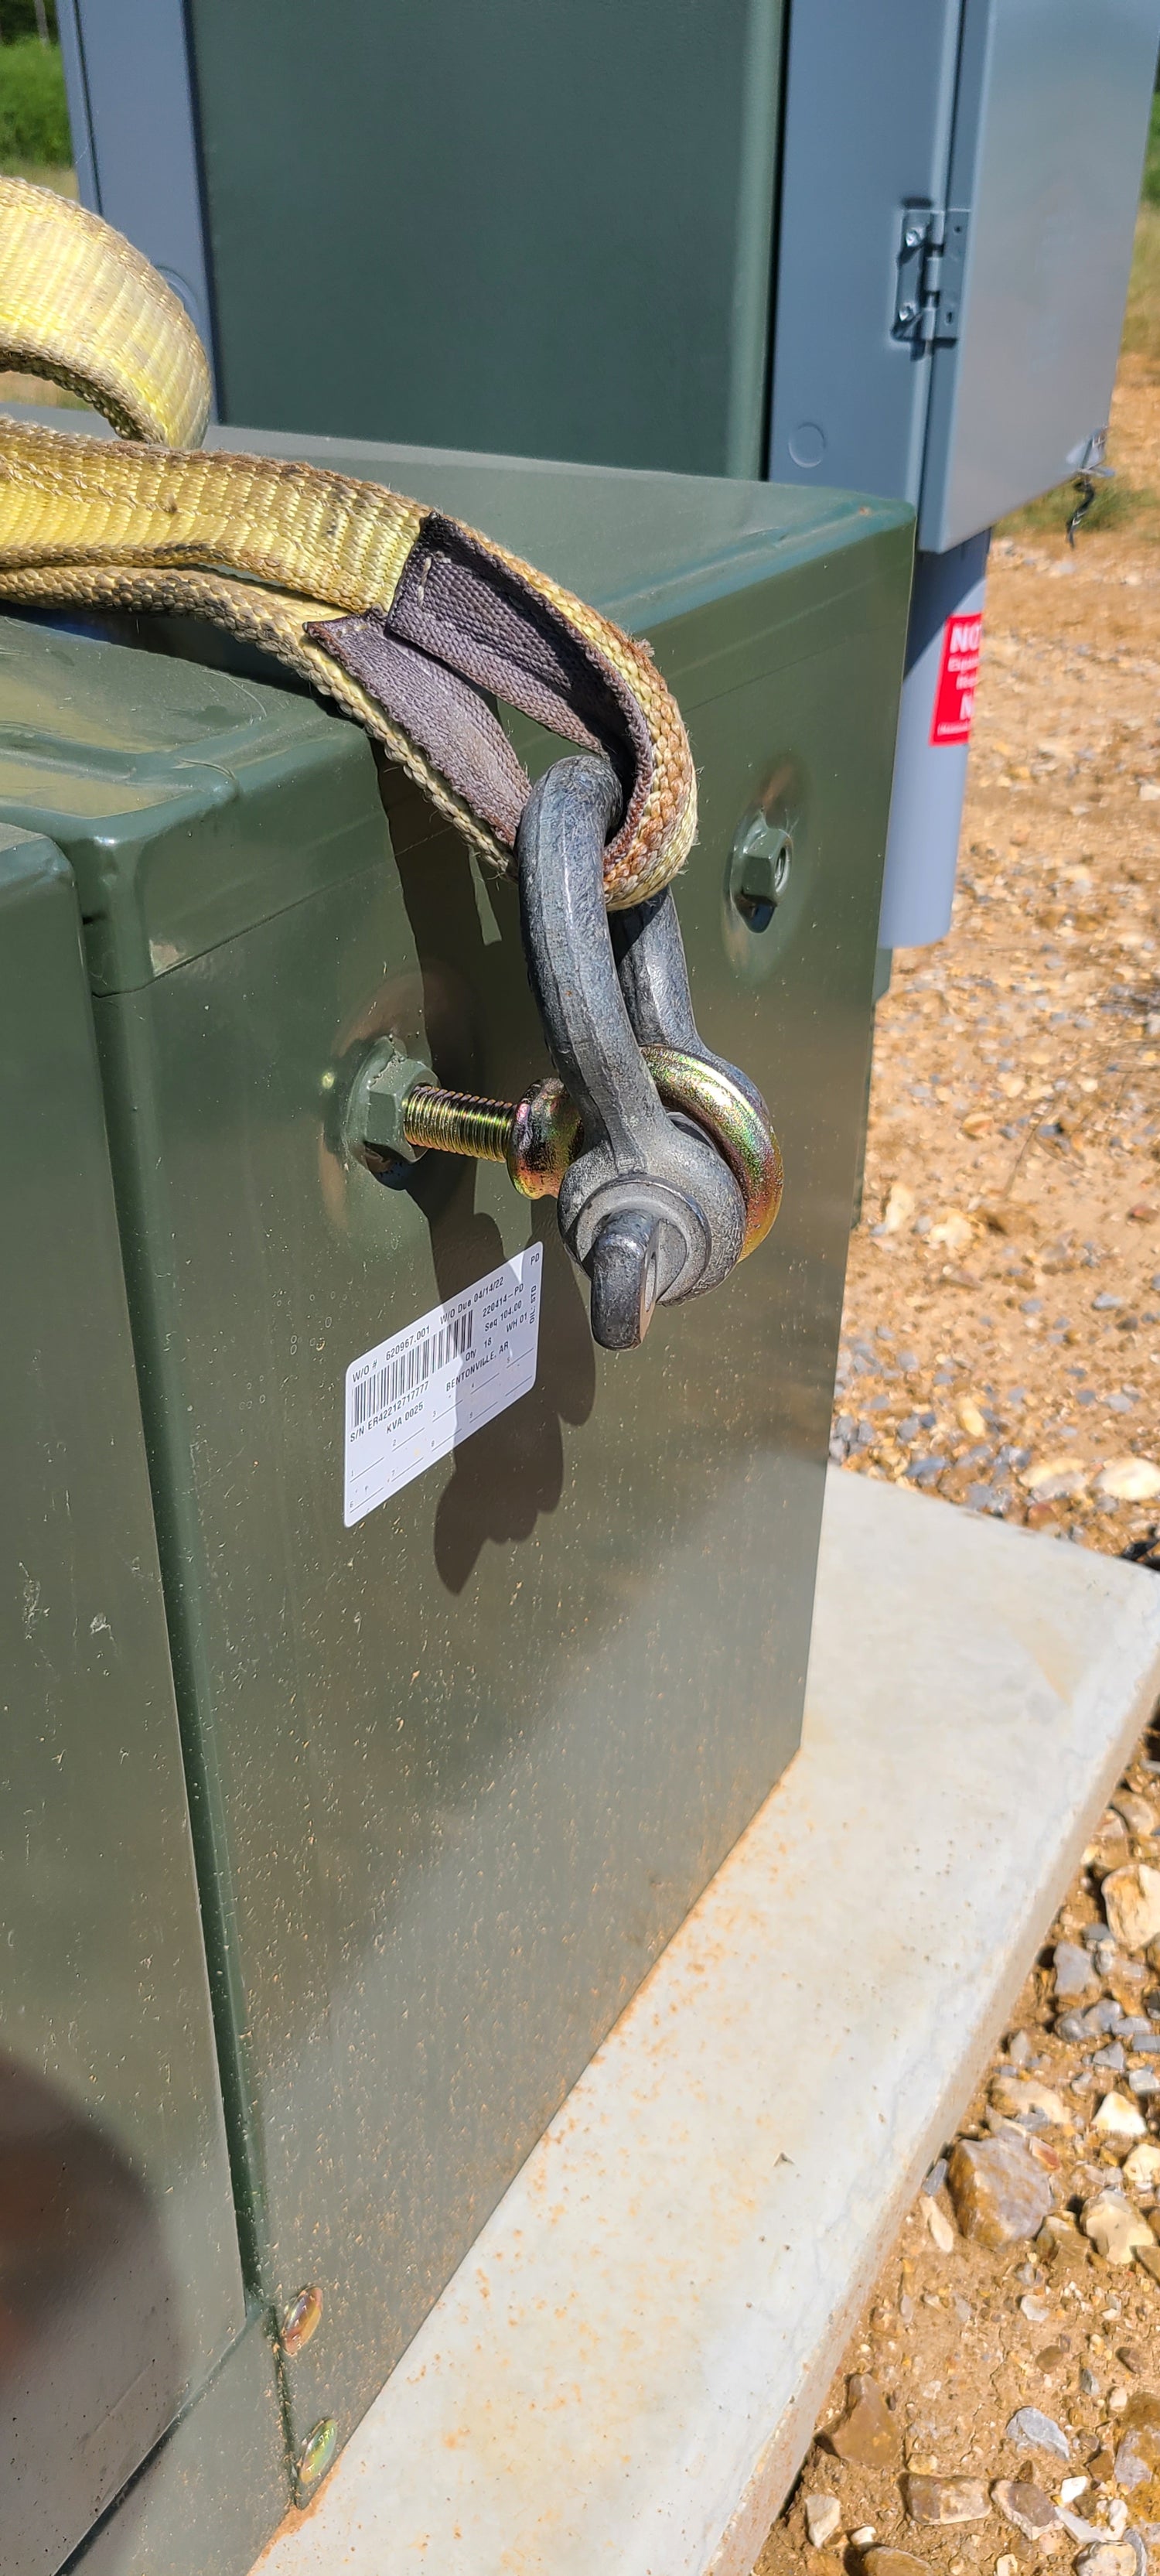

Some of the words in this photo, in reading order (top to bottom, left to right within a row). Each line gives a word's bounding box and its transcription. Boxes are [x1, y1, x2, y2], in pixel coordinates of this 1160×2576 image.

[950, 622, 981, 654] NO
[531, 1252, 539, 1266] PD
[353, 1365, 369, 1383] W/O
[385, 1325, 429, 1362] 620967.001
[440, 1308, 455, 1325] W/O
[458, 1298, 472, 1314] Due
[473, 1276, 503, 1303] 04/14/22
[485, 1318, 496, 1334] Seq
[500, 1300, 521, 1321] 104.00
[506, 1319, 517, 1333] WH
[520, 1312, 527, 1324] 01
[465, 1349, 476, 1362] Qty
[499, 1341, 508, 1354] AR
[350, 1424, 364, 1443] S/N
[367, 1381, 428, 1430] ER42212717777
[387, 1416, 402, 1434] KVA
[404, 1401, 423, 1422] 0025
